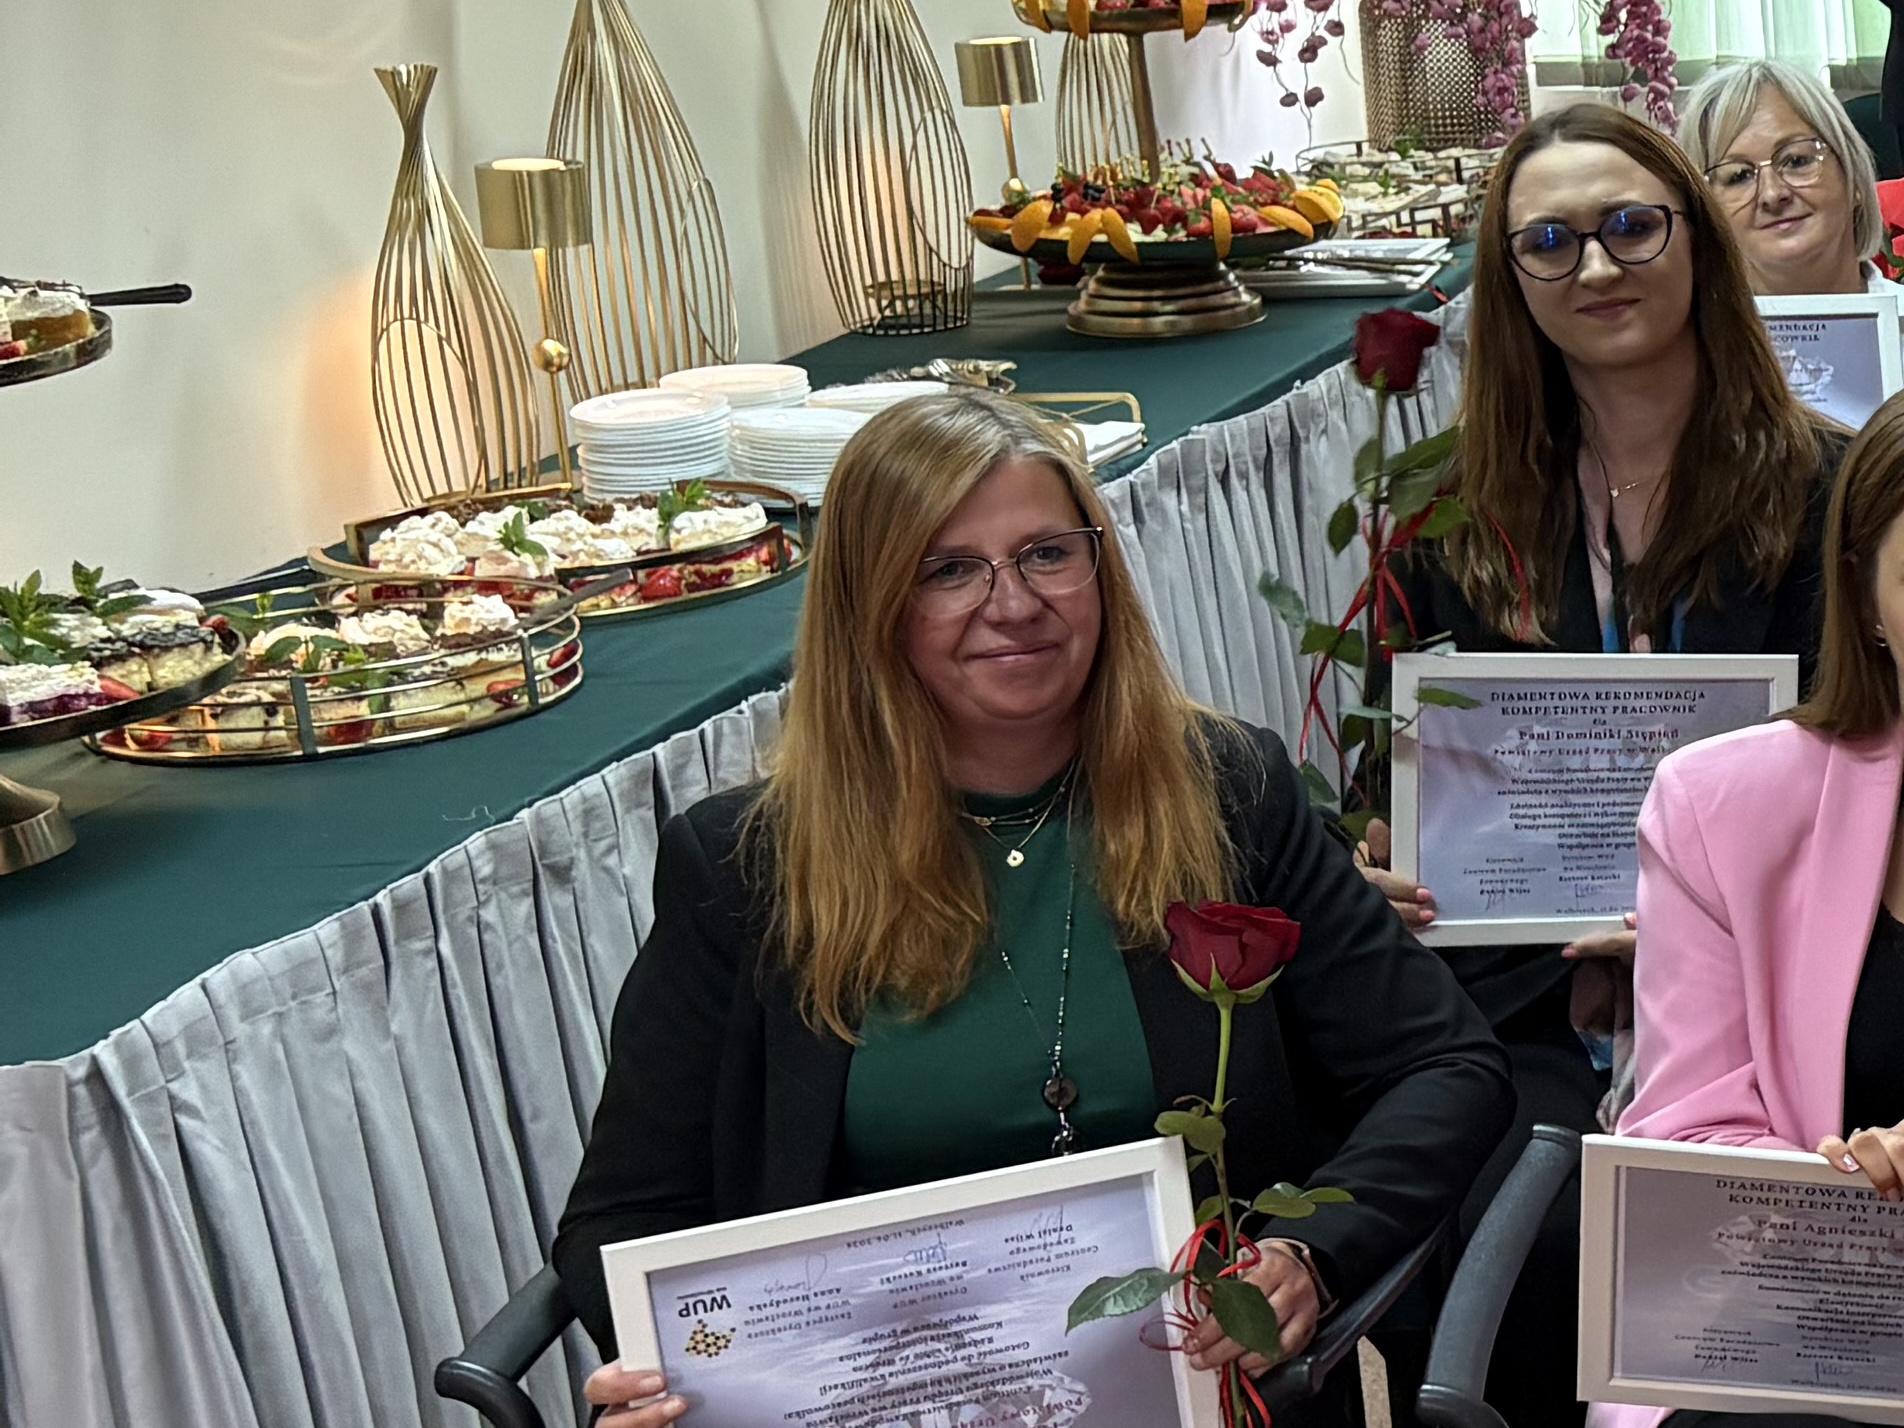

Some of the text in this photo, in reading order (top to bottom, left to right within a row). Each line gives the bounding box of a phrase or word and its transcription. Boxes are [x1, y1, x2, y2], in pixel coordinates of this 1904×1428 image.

[1490, 691, 1705, 701] DIAMENTOWA REKOMENDACJA
[1501, 704, 1697, 715] KOMPETENTNY PRACOWNIK
[1715, 1179, 1848, 1199] DIAMENTOWA
[1728, 1193, 1869, 1214] KOMPETENTNY
[1756, 1218, 1797, 1231] Pani
[1804, 1222, 1896, 1241] Agnieszki
[675, 1292, 731, 1319] WUP
